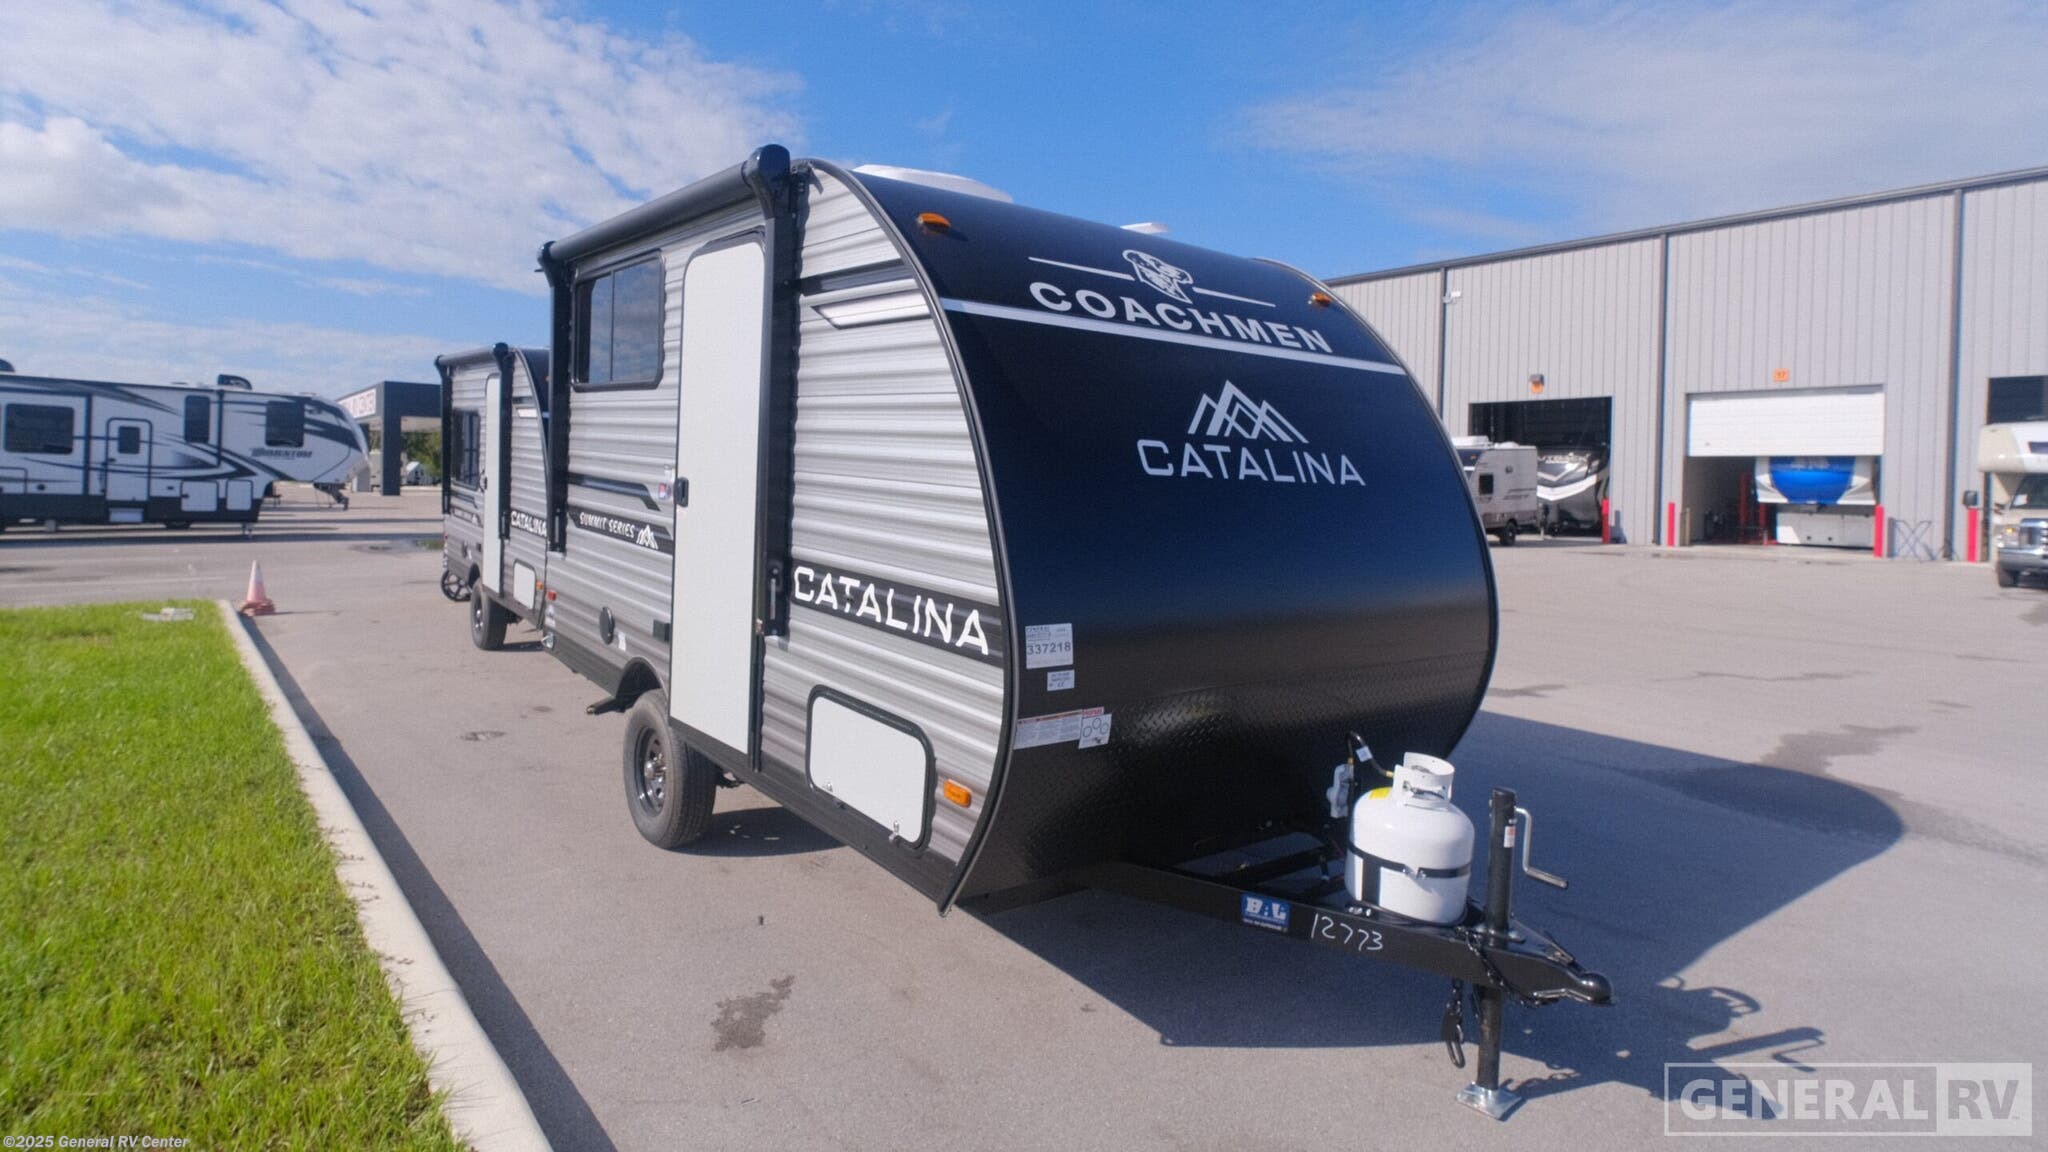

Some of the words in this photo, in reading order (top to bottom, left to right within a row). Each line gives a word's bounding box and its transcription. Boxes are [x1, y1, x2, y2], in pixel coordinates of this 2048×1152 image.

[1029, 281, 1333, 353] COACHMEN
[1136, 439, 1367, 486] CATALINA
[510, 509, 548, 538] CATALINA
[579, 511, 608, 531] SUMMIT
[608, 518, 635, 540] SERIES
[793, 565, 989, 656] CATALINA
[1026, 641, 1072, 656] 337218
[1310, 912, 1384, 951] 12773
